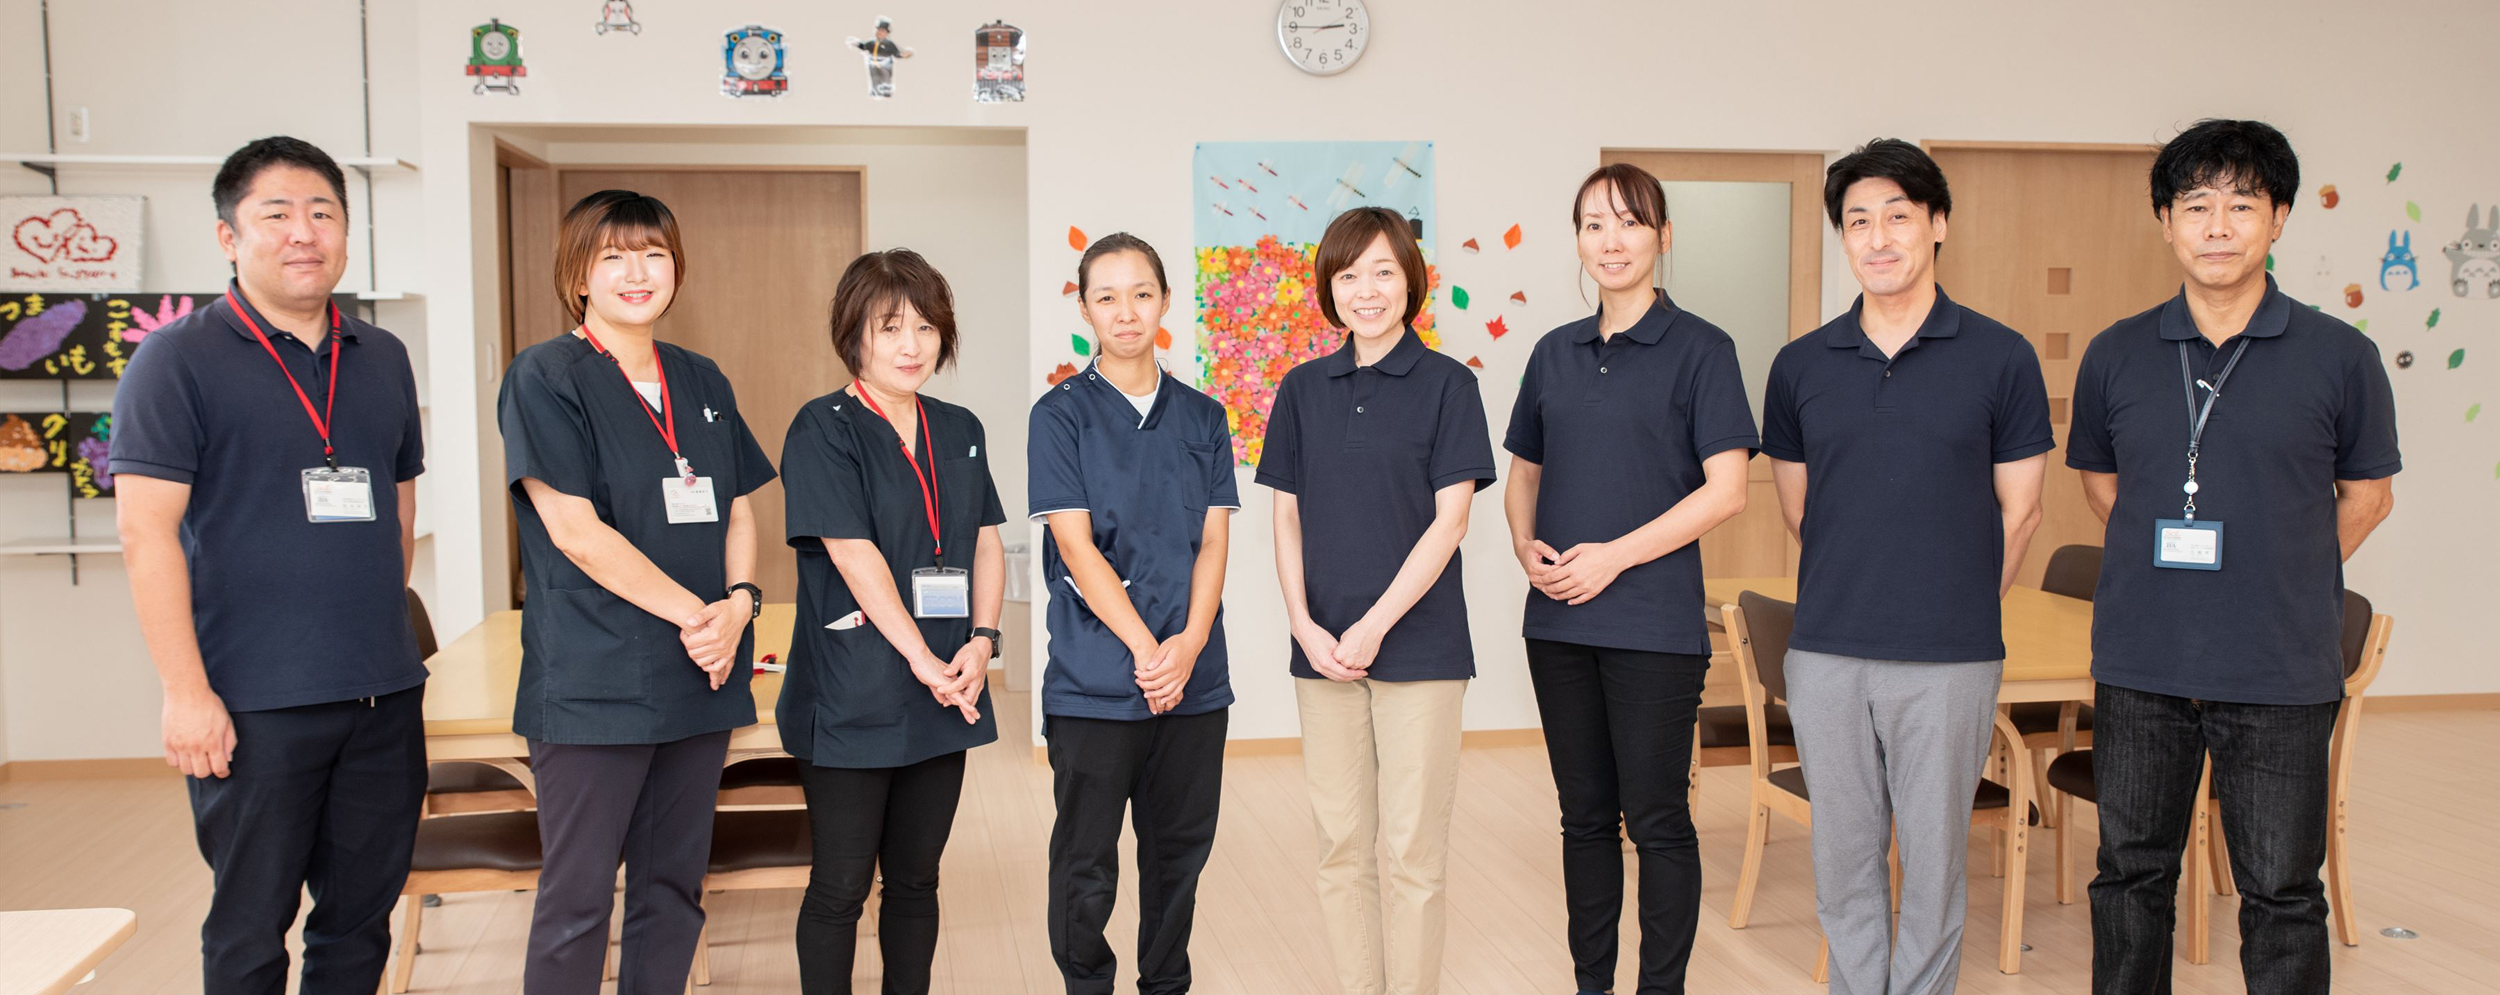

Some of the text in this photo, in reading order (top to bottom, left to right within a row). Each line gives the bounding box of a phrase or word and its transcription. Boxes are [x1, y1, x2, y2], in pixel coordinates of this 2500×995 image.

[1293, 6, 1305, 18] 10
[1345, 7, 1353, 19] 2
[1289, 21, 1298, 33] 9
[1349, 23, 1358, 35] 3
[1293, 37, 1302, 49] 8
[1345, 38, 1353, 50] 4
[1304, 48, 1312, 60] 7
[1319, 53, 1327, 65] 6
[1334, 49, 1342, 61] 5
[45, 344, 95, 375] いも
